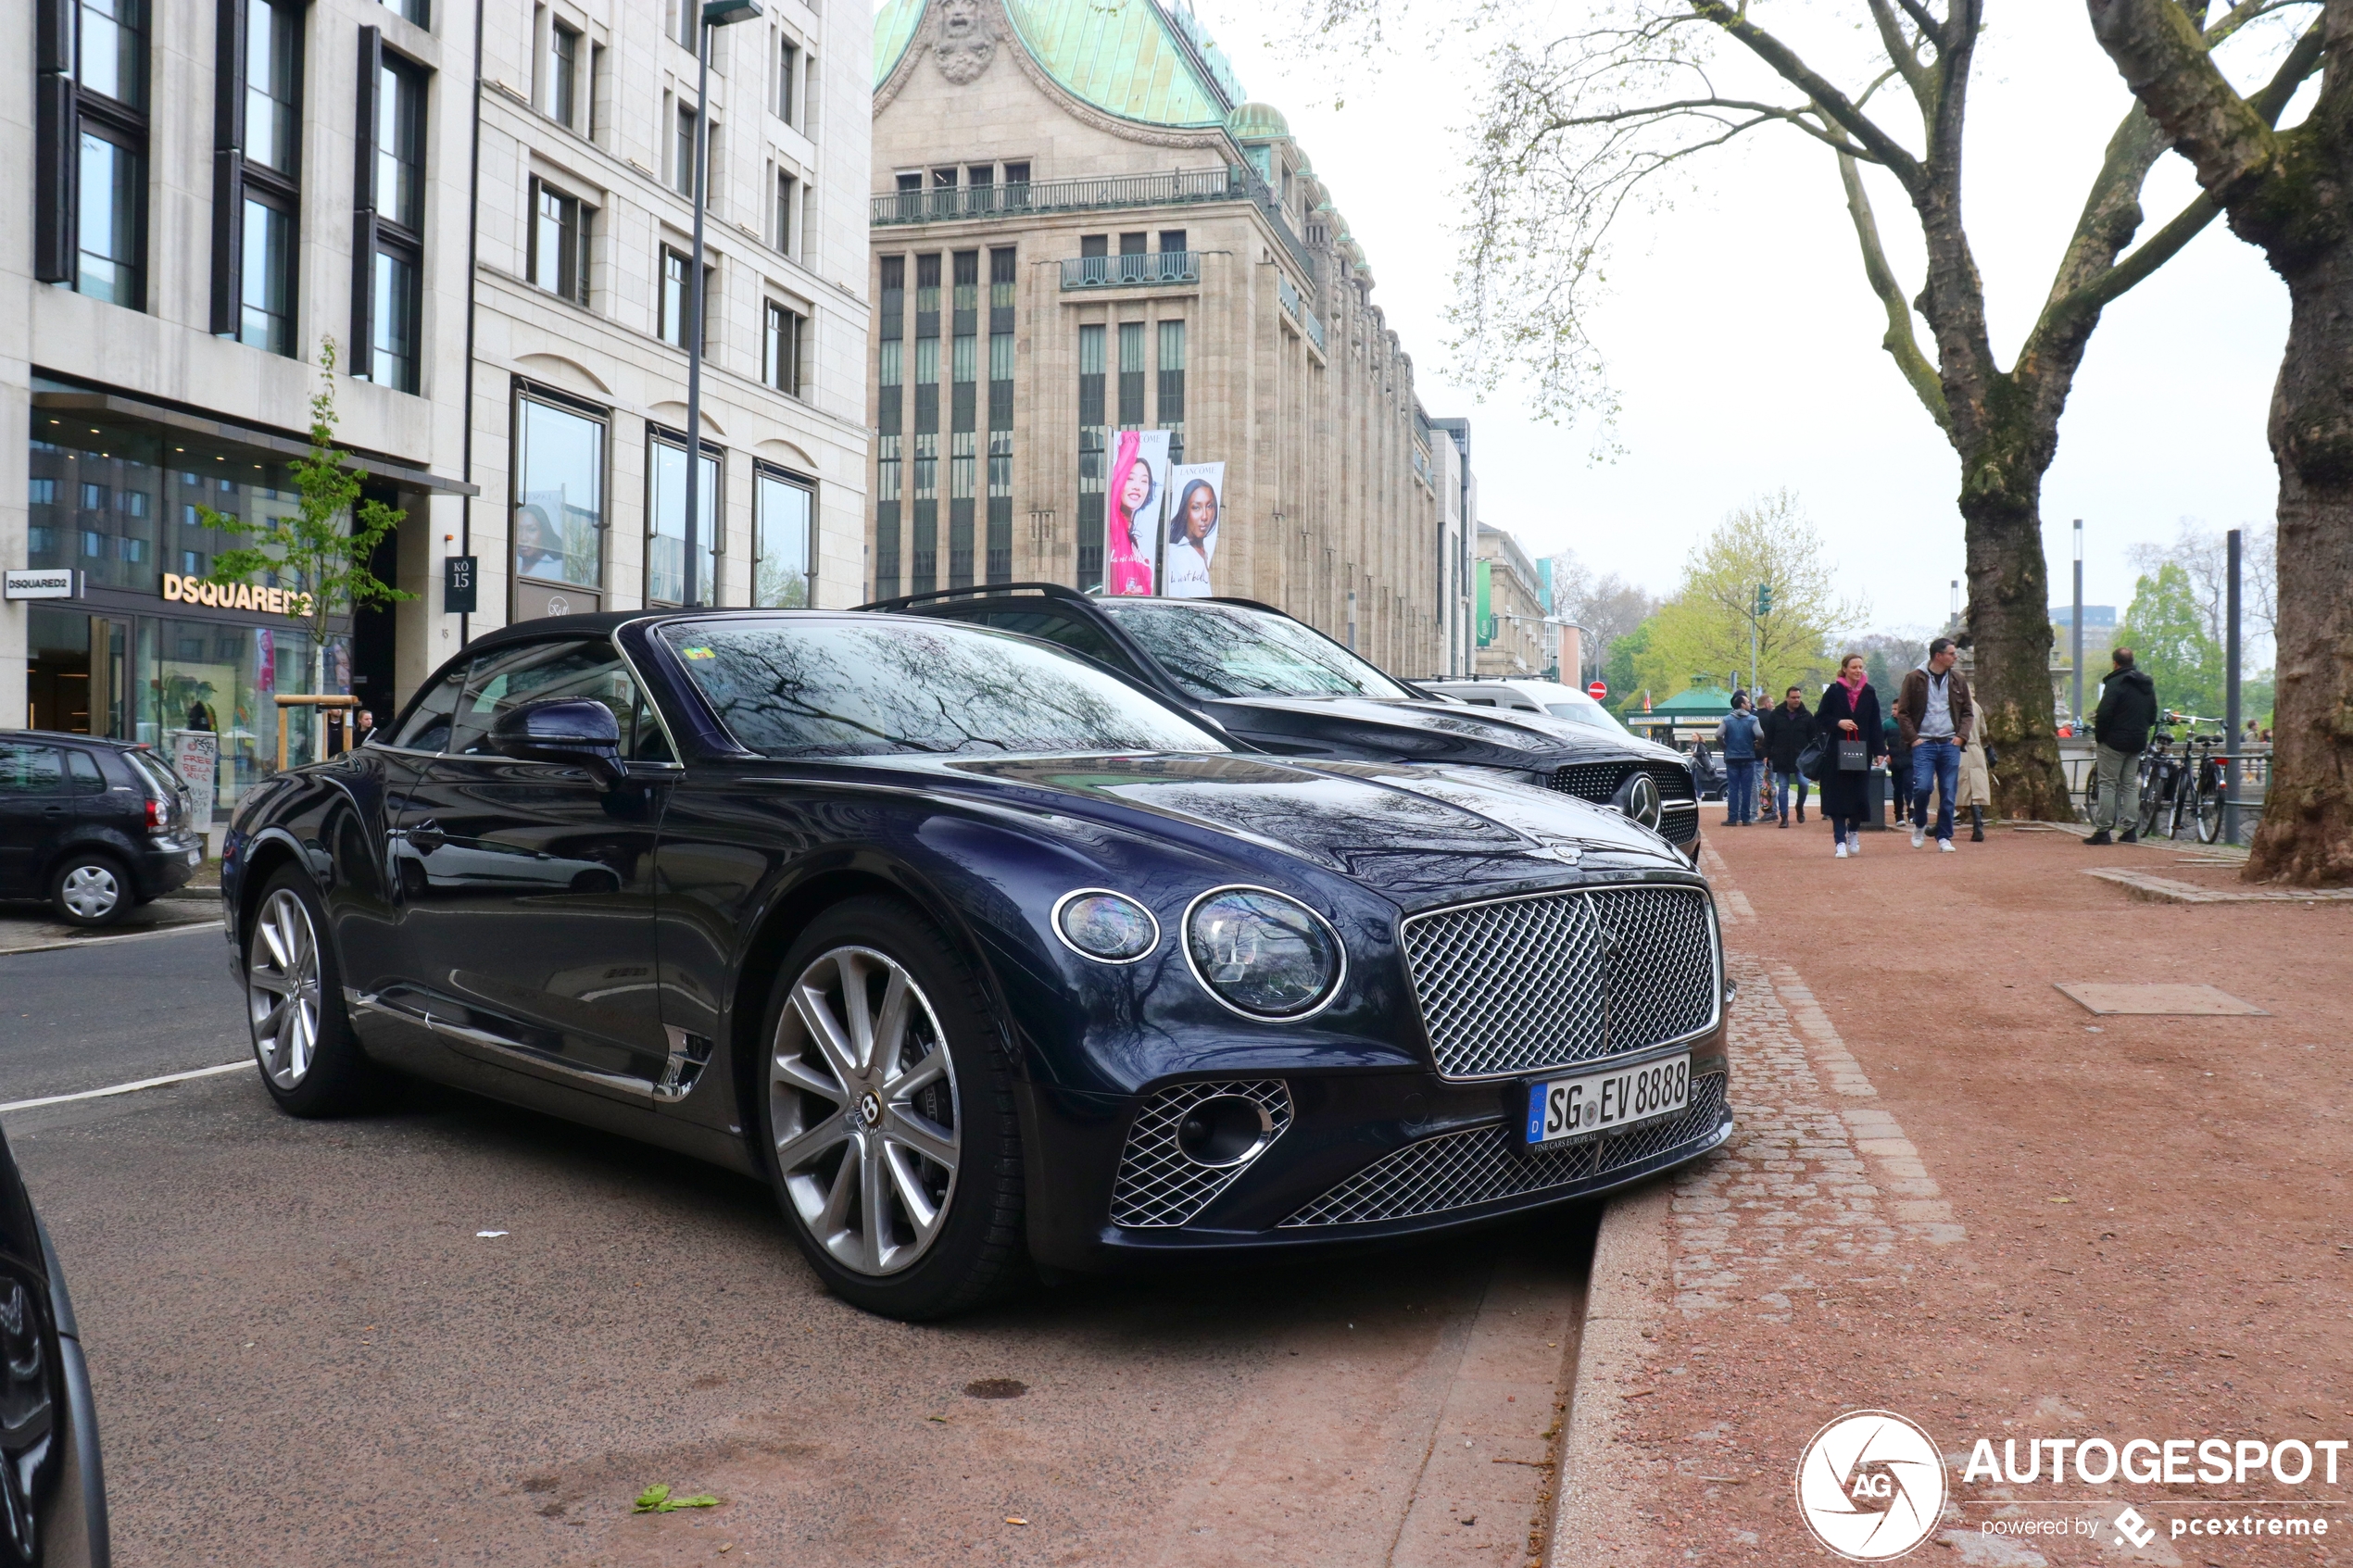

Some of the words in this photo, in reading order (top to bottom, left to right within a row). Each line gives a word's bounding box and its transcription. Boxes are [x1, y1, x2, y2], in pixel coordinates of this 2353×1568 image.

[1179, 466, 1216, 476] LANCÔME
[453, 560, 470, 572] KÖ
[8, 579, 67, 589] DSQUARED2
[453, 573, 470, 588] 15
[183, 755, 213, 765] FREE
[1547, 1085, 1583, 1133] SG
[1600, 1075, 1631, 1123] EV
[1635, 1060, 1686, 1114] 8888
[1531, 1121, 1540, 1134] D
[1534, 1143, 1549, 1152] FINE
[1550, 1139, 1566, 1149] CARS
[1567, 1135, 1588, 1146] EUROPE
